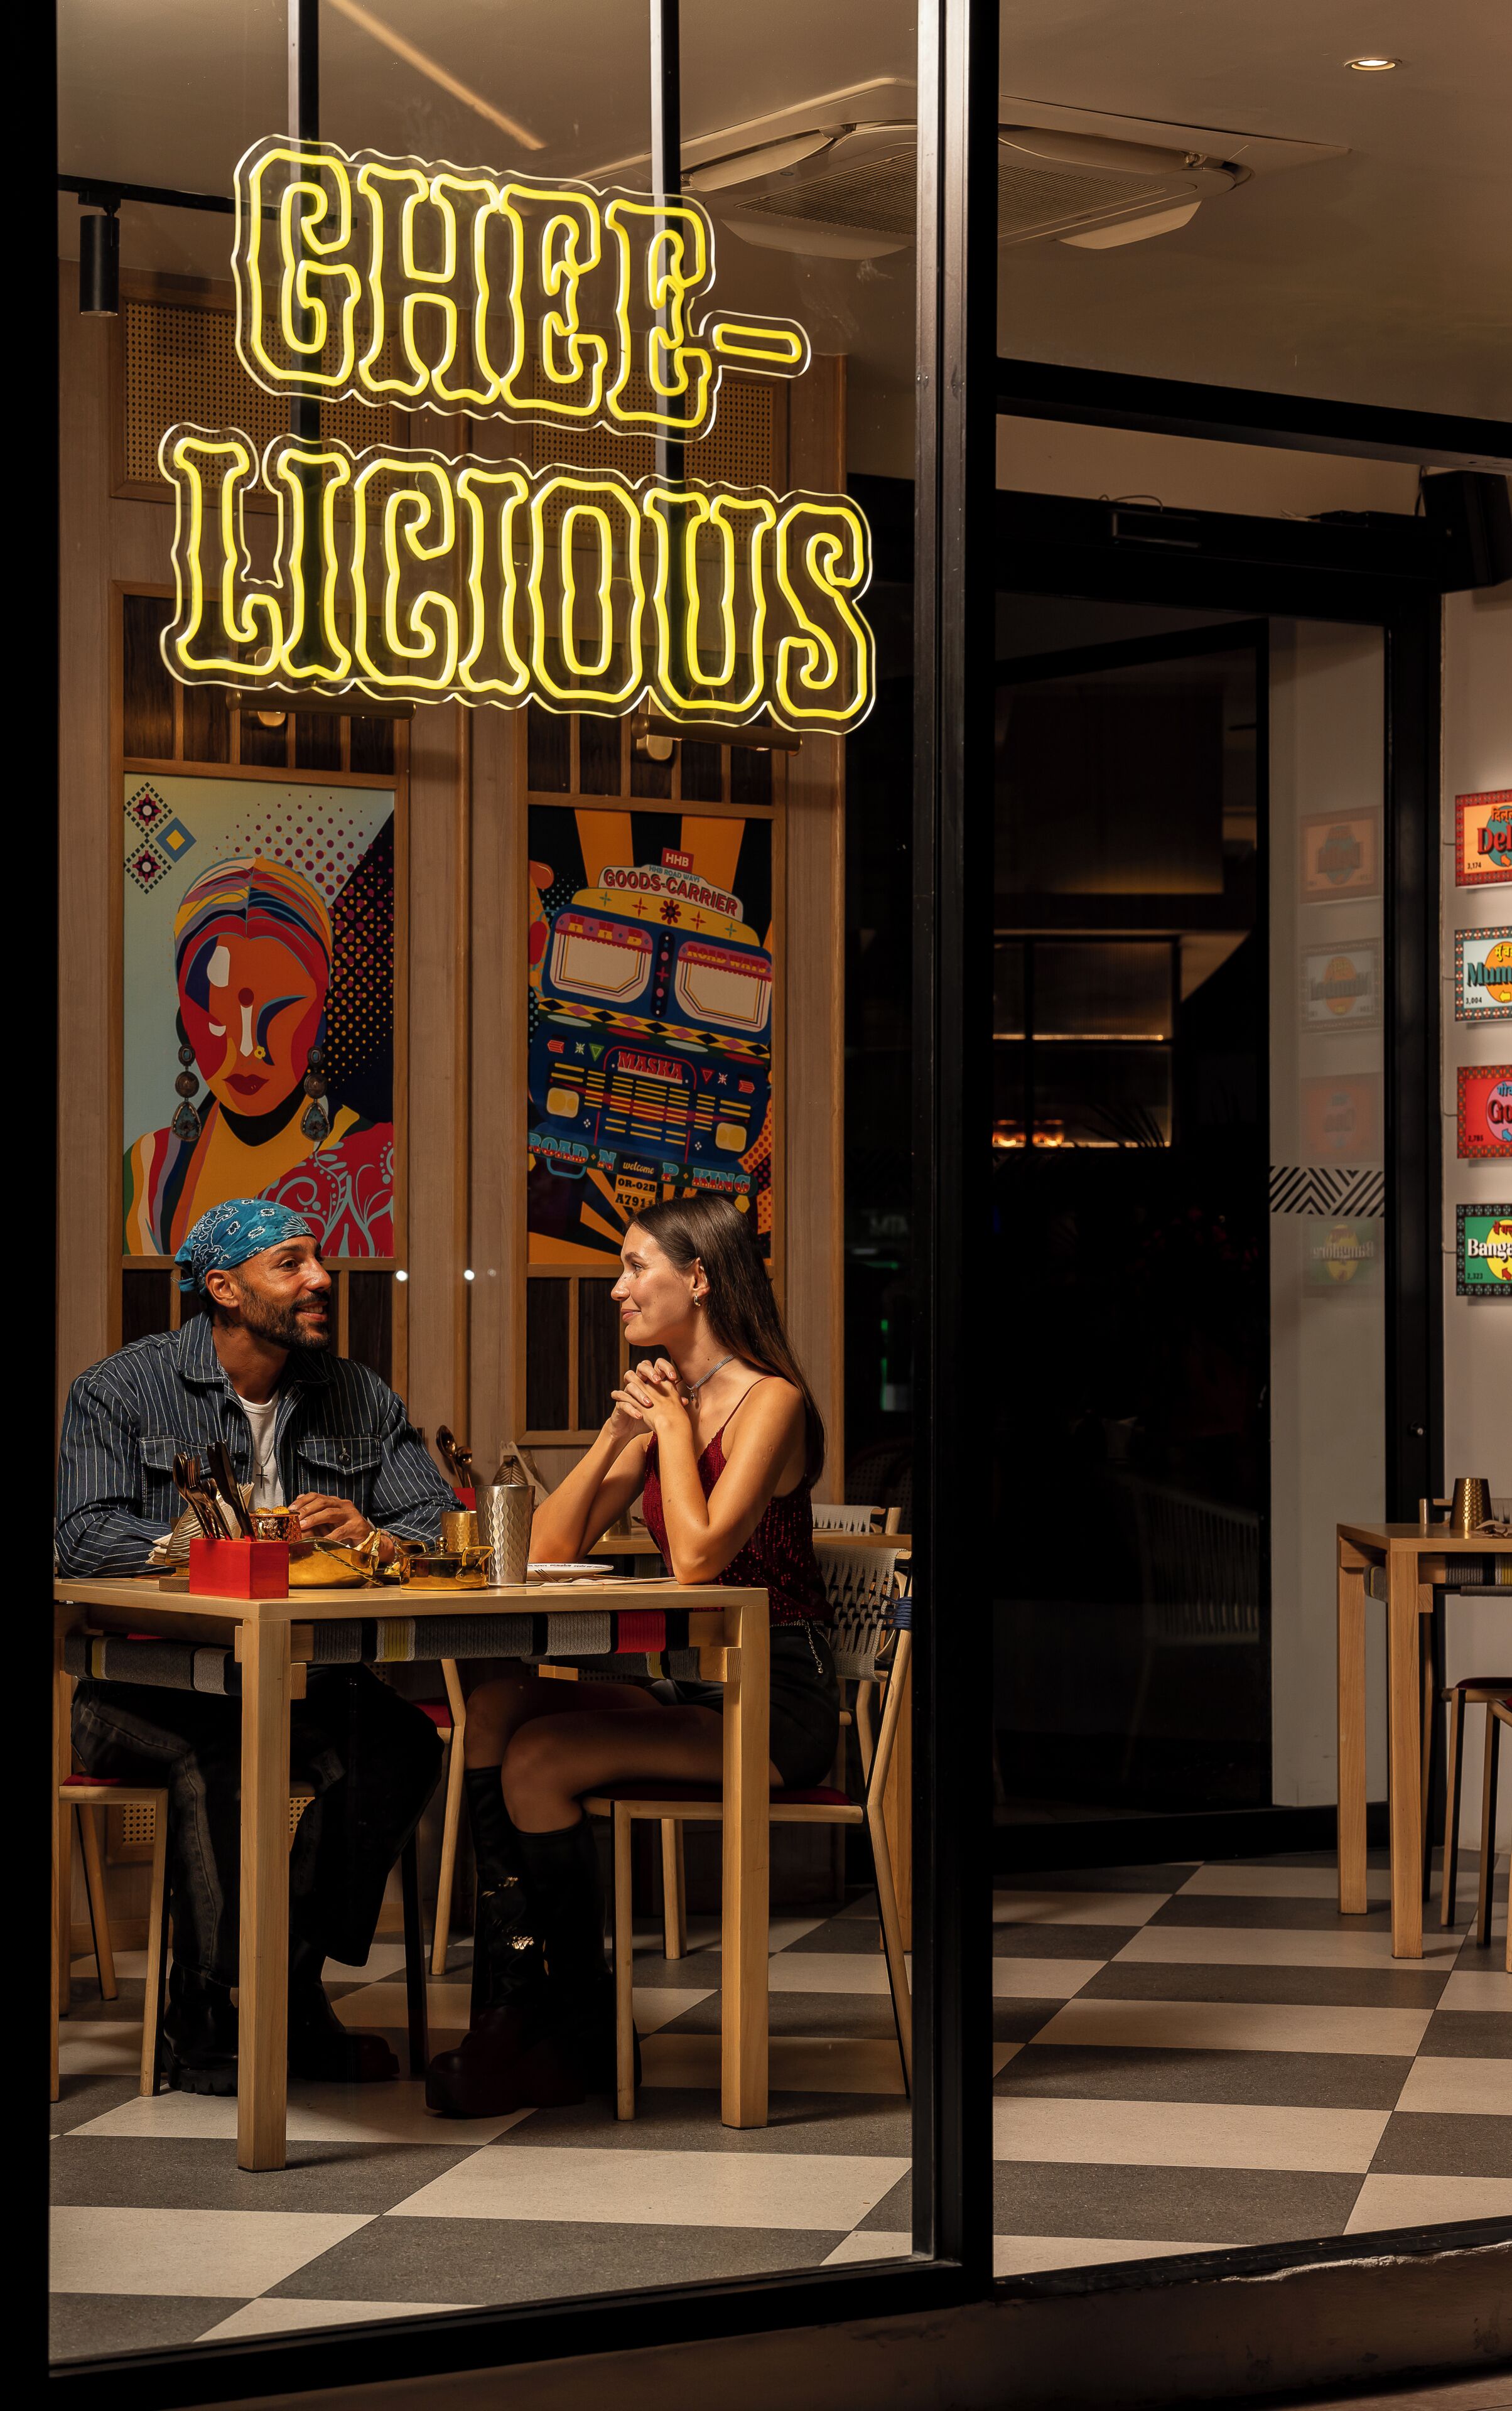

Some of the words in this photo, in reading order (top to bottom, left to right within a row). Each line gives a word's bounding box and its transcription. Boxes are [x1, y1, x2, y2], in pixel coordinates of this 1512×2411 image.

[249, 148, 802, 428] GHEE-
[173, 438, 867, 718] LICIOUS
[649, 865, 663, 874] HHB
[664, 868, 682, 879] ROAD
[683, 873, 701, 883] WAYS
[666, 853, 689, 867] HHB
[603, 868, 738, 917] GOODS-CARRIER
[687, 945, 727, 964] ROAD
[728, 954, 766, 973] WAYS
[618, 1051, 683, 1080] MASKA
[528, 1132, 589, 1164] ROAD
[597, 1149, 617, 1171] N
[661, 1162, 679, 1182] P
[691, 1167, 751, 1194] KING
[622, 1161, 655, 1175] welcome
